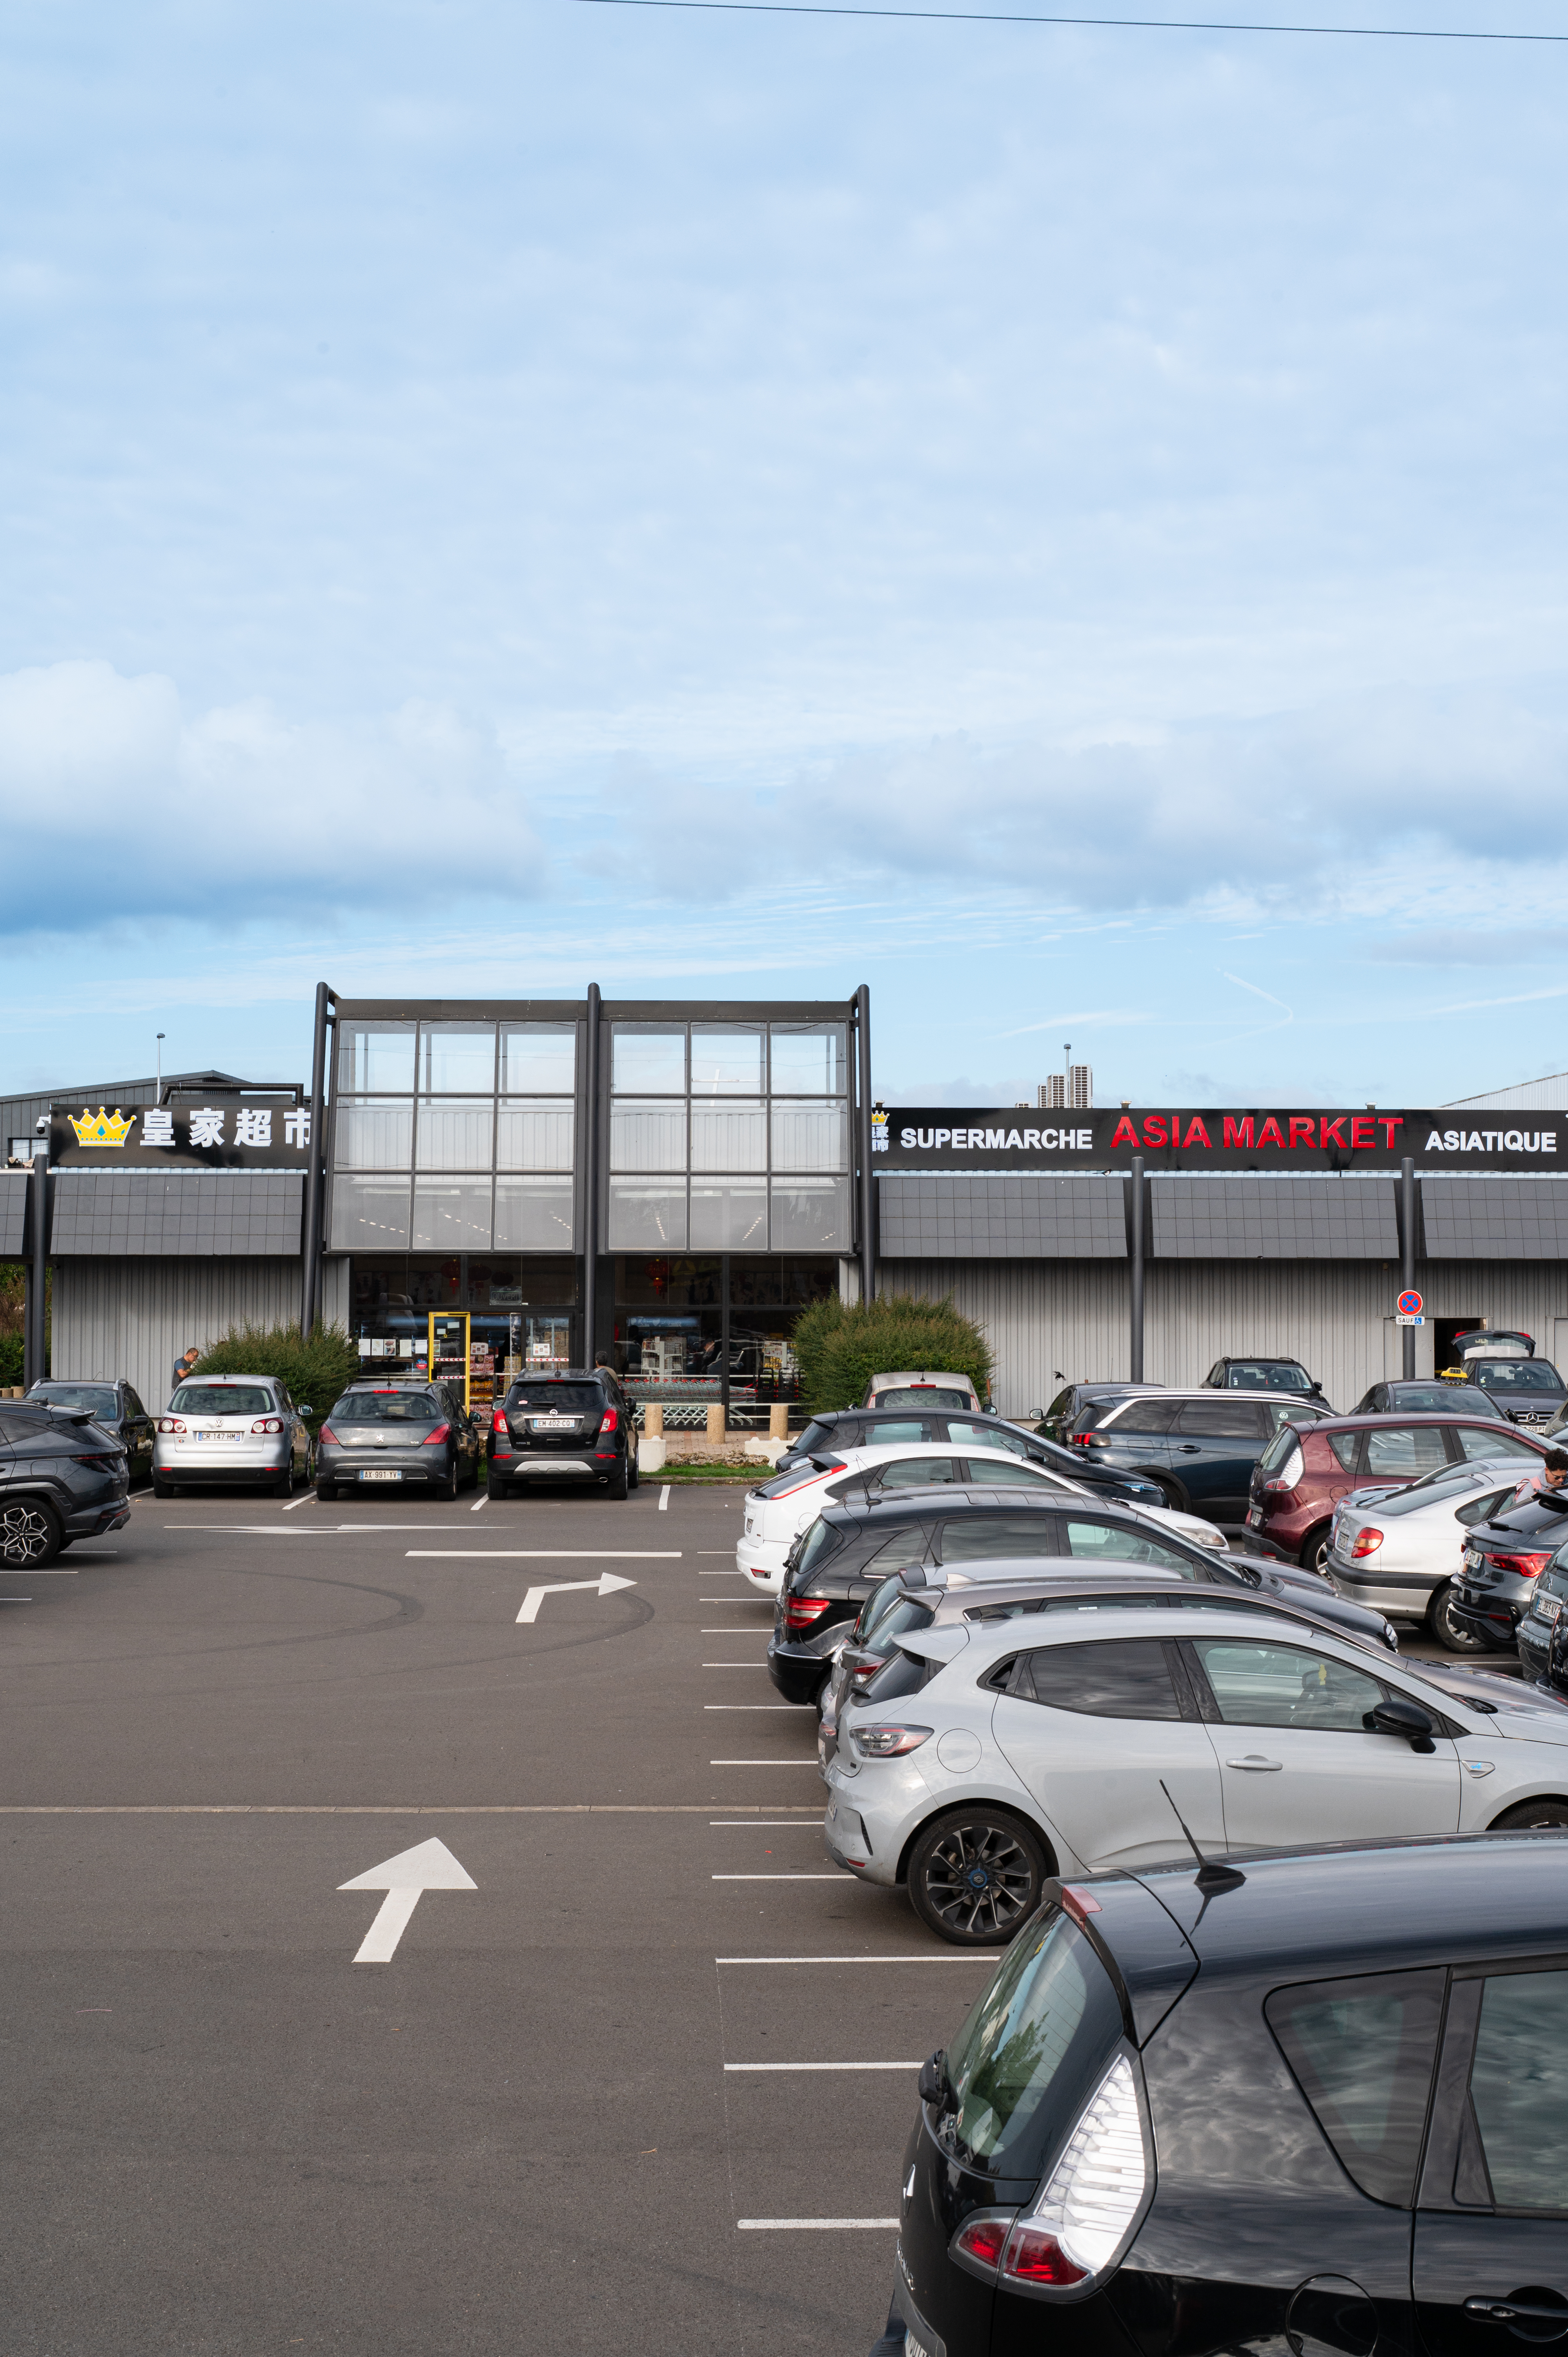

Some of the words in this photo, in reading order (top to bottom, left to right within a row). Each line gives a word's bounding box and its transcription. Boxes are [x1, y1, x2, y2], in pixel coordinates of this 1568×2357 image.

[140, 1108, 311, 1148] 皇家超市
[900, 1128, 1093, 1149] SUPERMARCHE
[1110, 1115, 1213, 1148] ASIA
[1223, 1116, 1404, 1149] MARKET
[1425, 1130, 1557, 1152] ASIATIQUE
